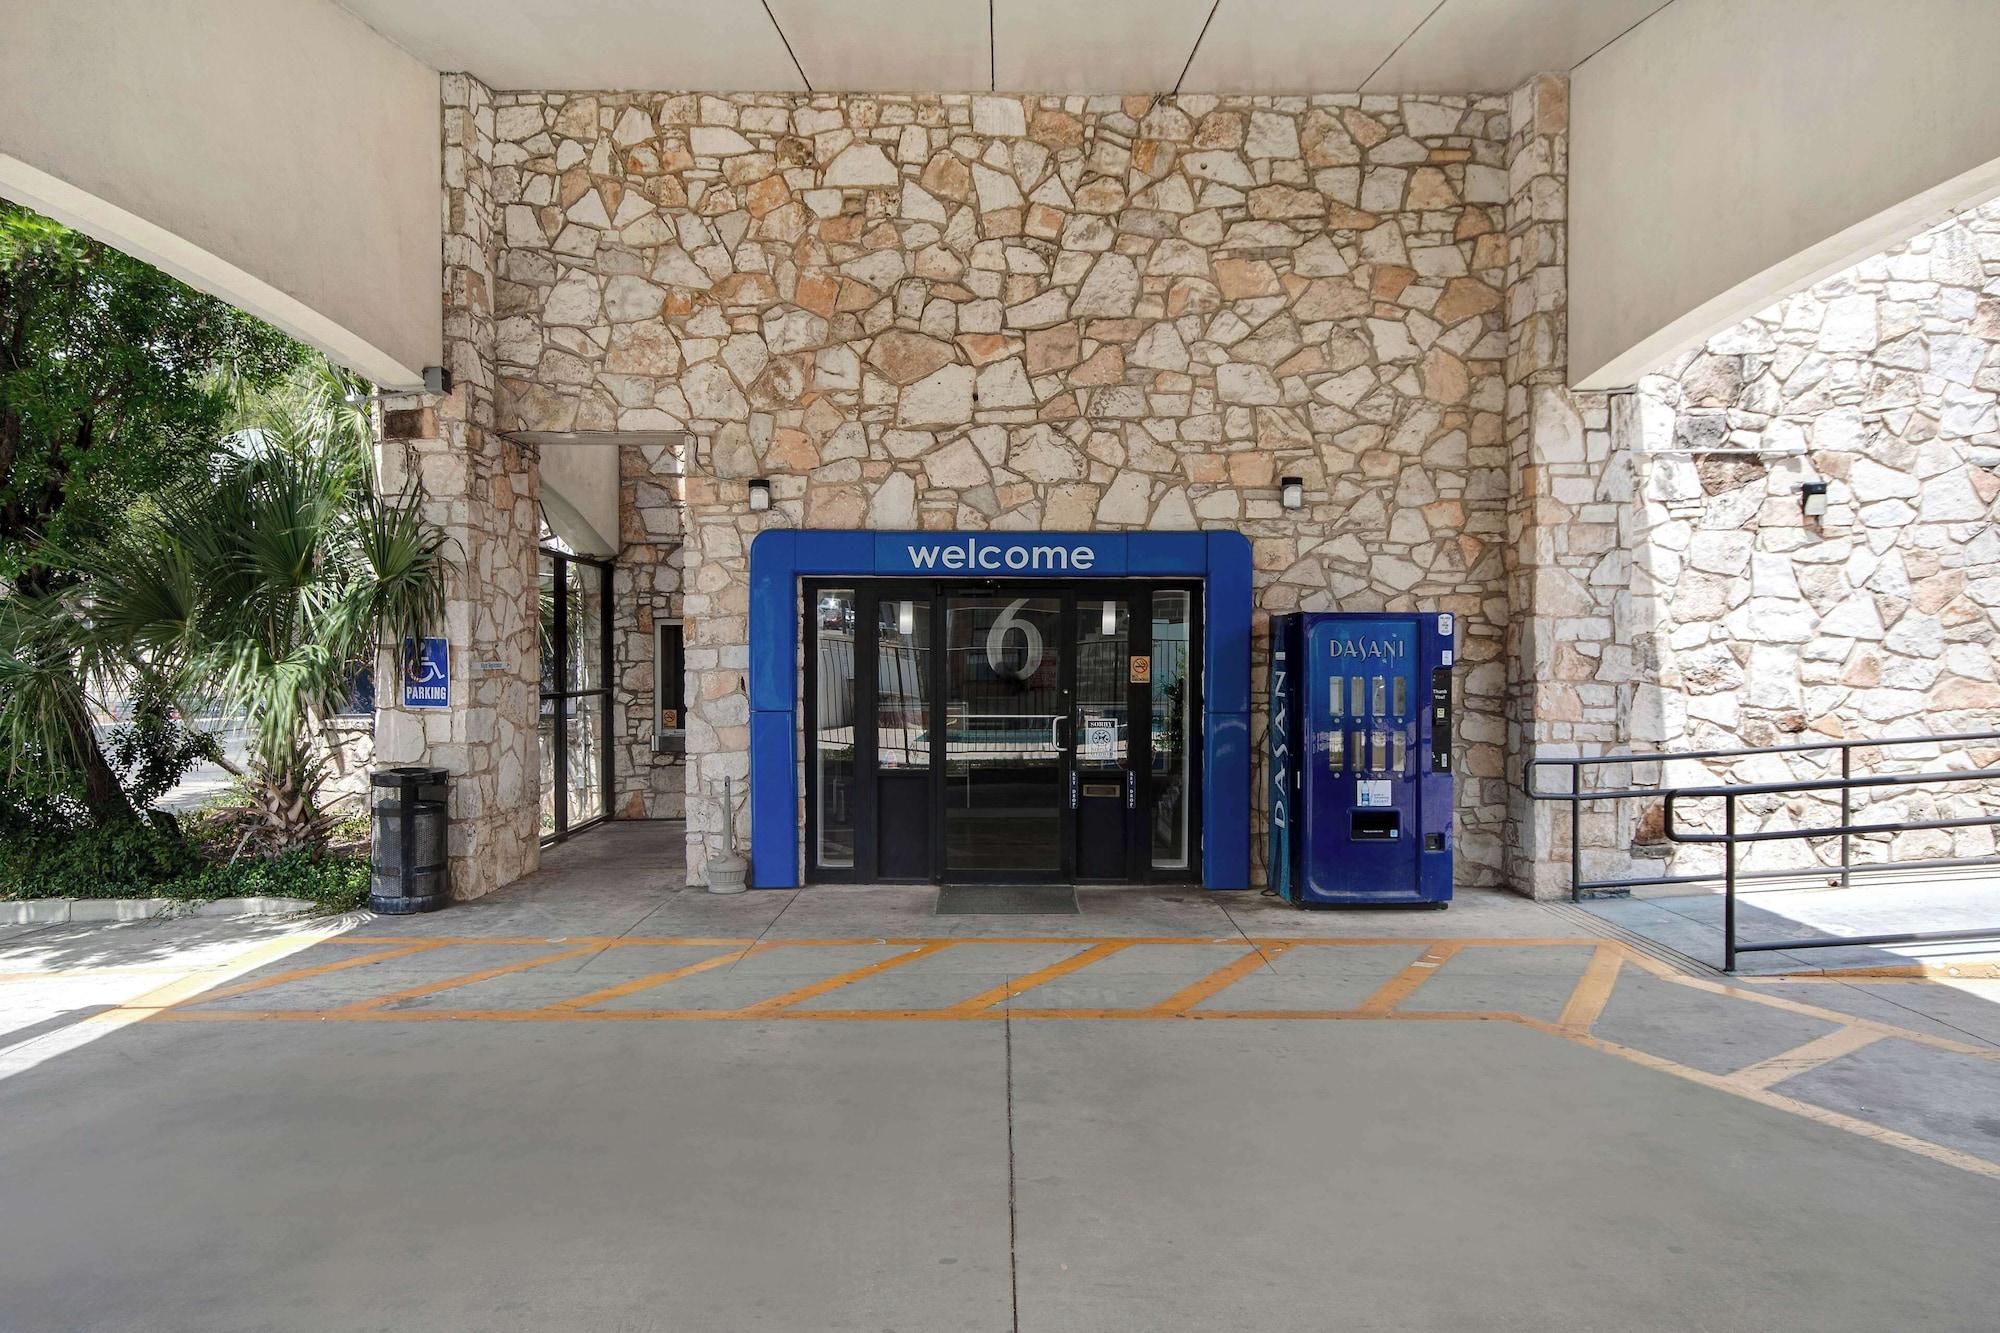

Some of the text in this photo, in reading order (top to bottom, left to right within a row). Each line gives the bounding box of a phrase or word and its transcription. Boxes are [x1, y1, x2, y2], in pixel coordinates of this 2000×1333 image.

[907, 538, 1095, 570] welcome
[986, 598, 1043, 681] 6
[1330, 635, 1404, 662] DASANI
[406, 686, 447, 700] PARKING
[1272, 651, 1288, 829] DASANI
